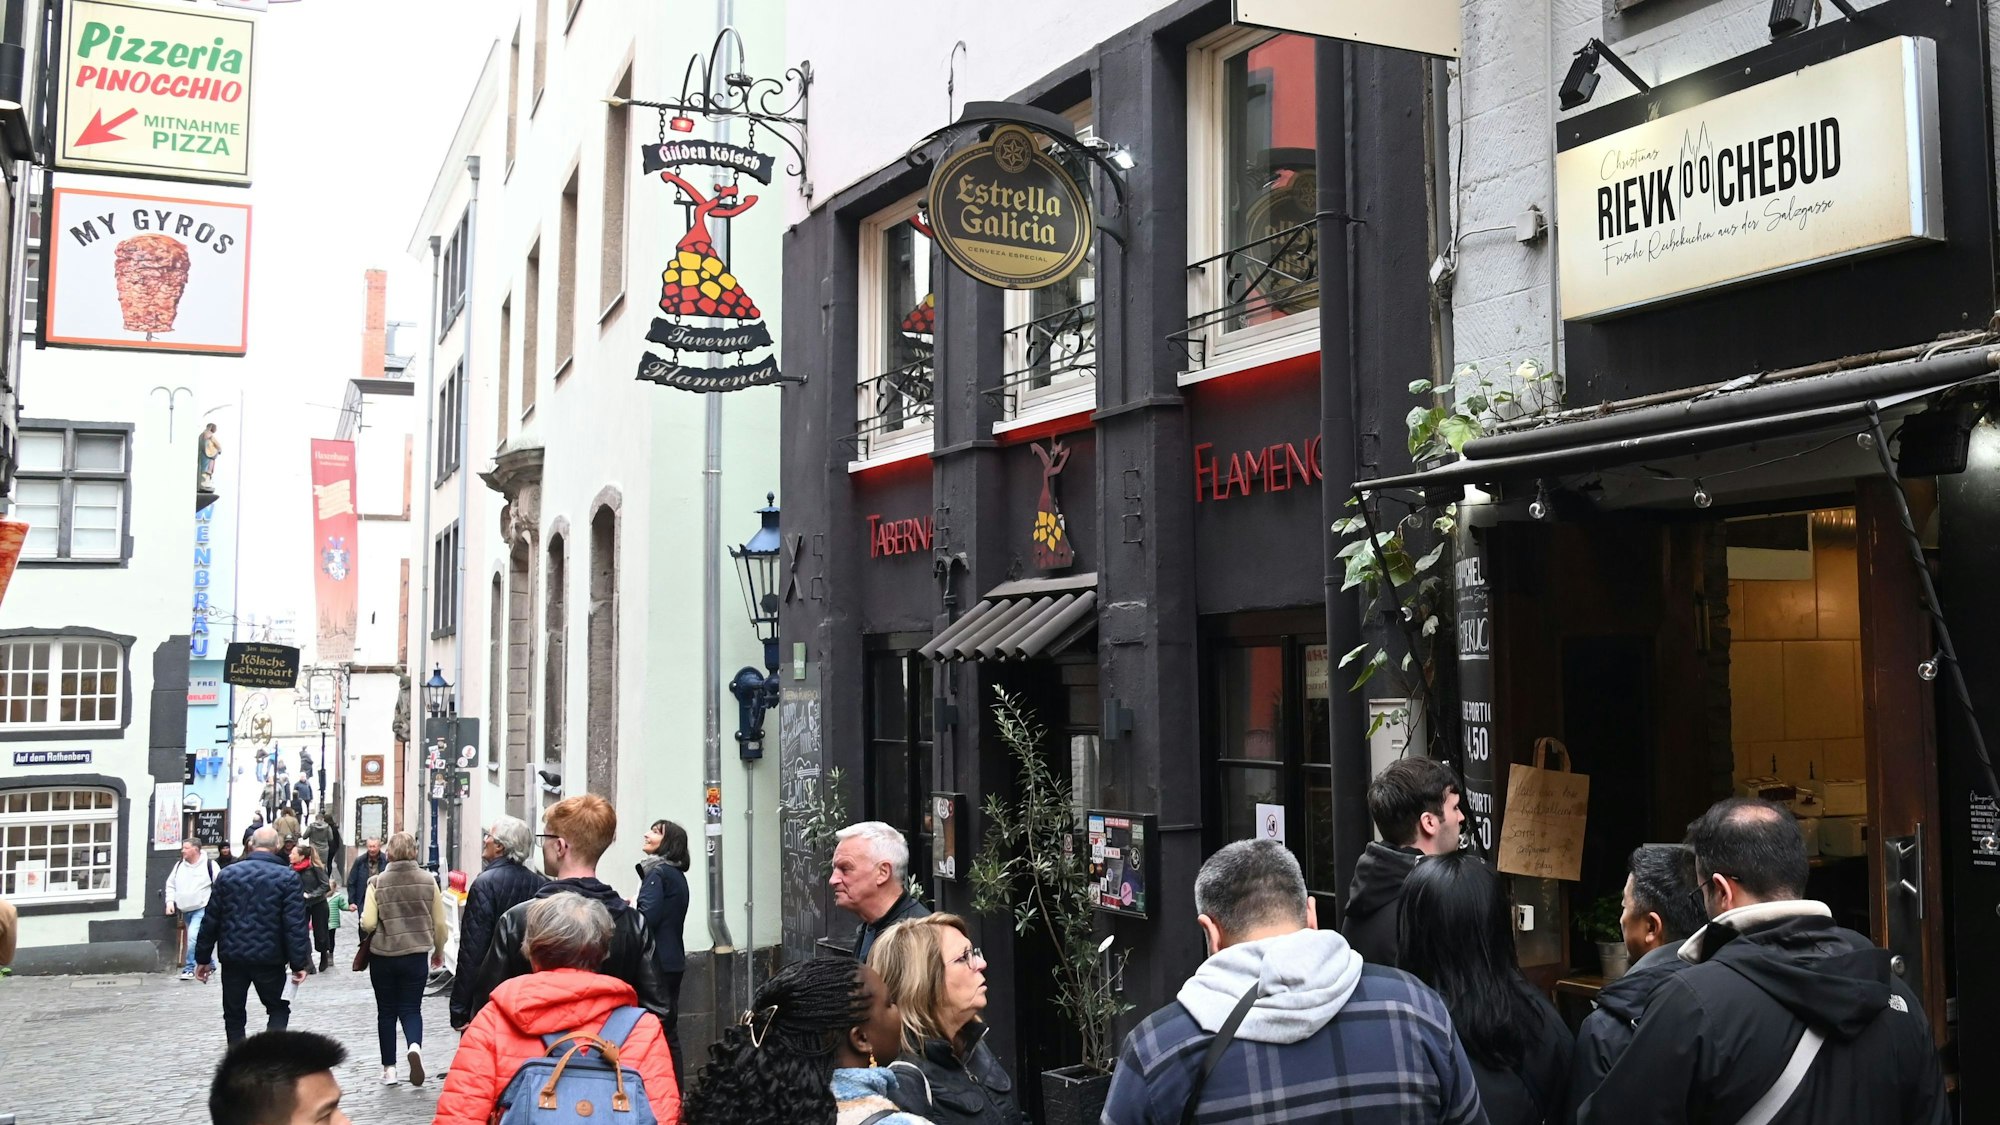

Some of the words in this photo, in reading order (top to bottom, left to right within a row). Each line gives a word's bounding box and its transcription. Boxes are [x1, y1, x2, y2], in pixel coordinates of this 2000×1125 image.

[77, 22, 243, 74] Pizzeria
[75, 65, 242, 102] PINOCCHIO
[143, 114, 240, 135] MITNAHME
[152, 132, 230, 156] PIZZA
[658, 145, 706, 163] Gilden
[710, 145, 761, 171] Kölsch
[1600, 147, 1660, 181] Christinas
[956, 173, 1062, 217] Estrella
[69, 212, 116, 247] MY
[132, 209, 234, 254] GYROS
[961, 205, 1056, 245] Galicia
[1602, 239, 1645, 276] Frische
[1648, 222, 1715, 262] Reibekuchen
[1718, 223, 1739, 237] aus
[1741, 210, 1759, 231] der
[1764, 196, 1834, 232] Salzgasse
[968, 246, 1006, 257] CERVEZA
[1009, 252, 1048, 263] ESPECIAL
[668, 327, 751, 347] Taverna
[230, 663, 293, 678] Lebensart
[240, 653, 286, 669] Kölsche
[16, 752, 29, 763] Auf
[30, 752, 46, 763] dem
[47, 752, 90, 763] Rothenberg
